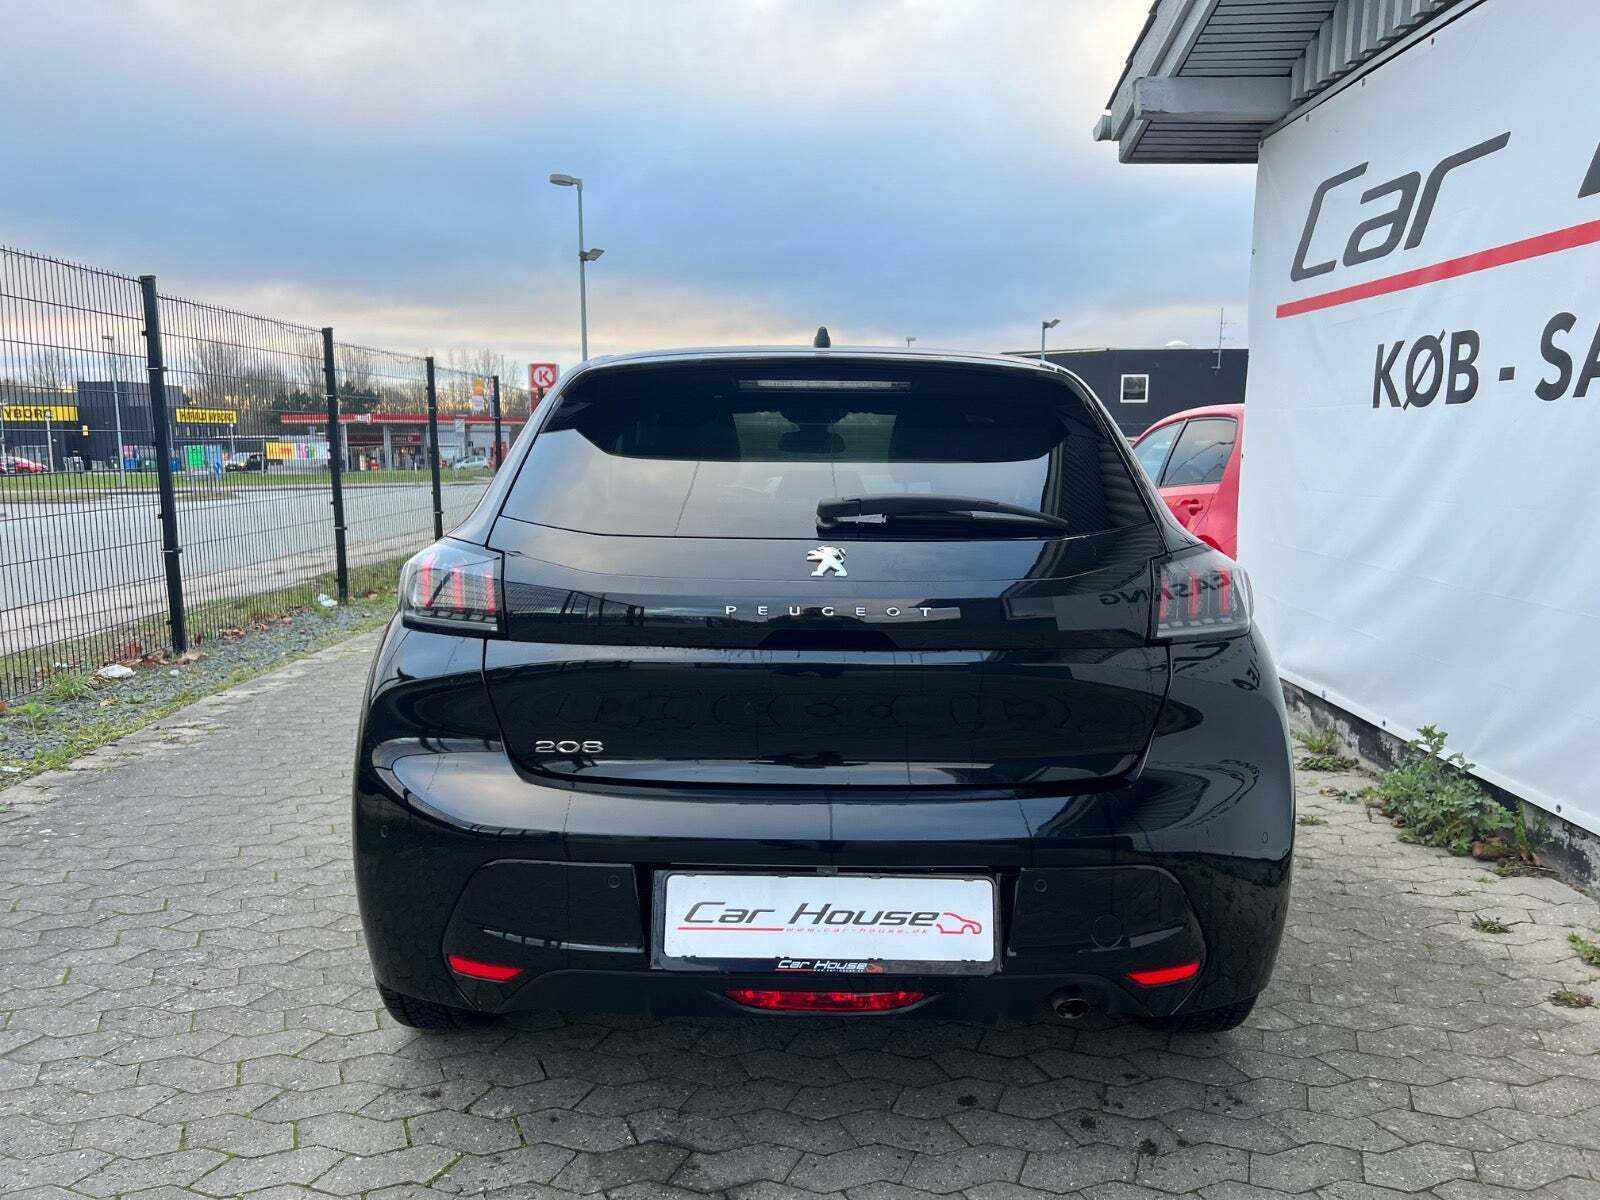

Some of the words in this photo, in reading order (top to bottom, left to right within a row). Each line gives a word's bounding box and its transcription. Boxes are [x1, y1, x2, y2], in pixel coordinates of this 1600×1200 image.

[1290, 131, 1511, 282] Car
[1372, 328, 1480, 411] KØB
[538, 369, 553, 386] K
[0, 408, 52, 419] YBORG
[725, 605, 932, 617] PEUGEOT
[534, 740, 604, 753] 208
[683, 901, 776, 924] Car
[787, 902, 940, 927] House
[777, 959, 811, 969] Car
[813, 959, 868, 970] House
